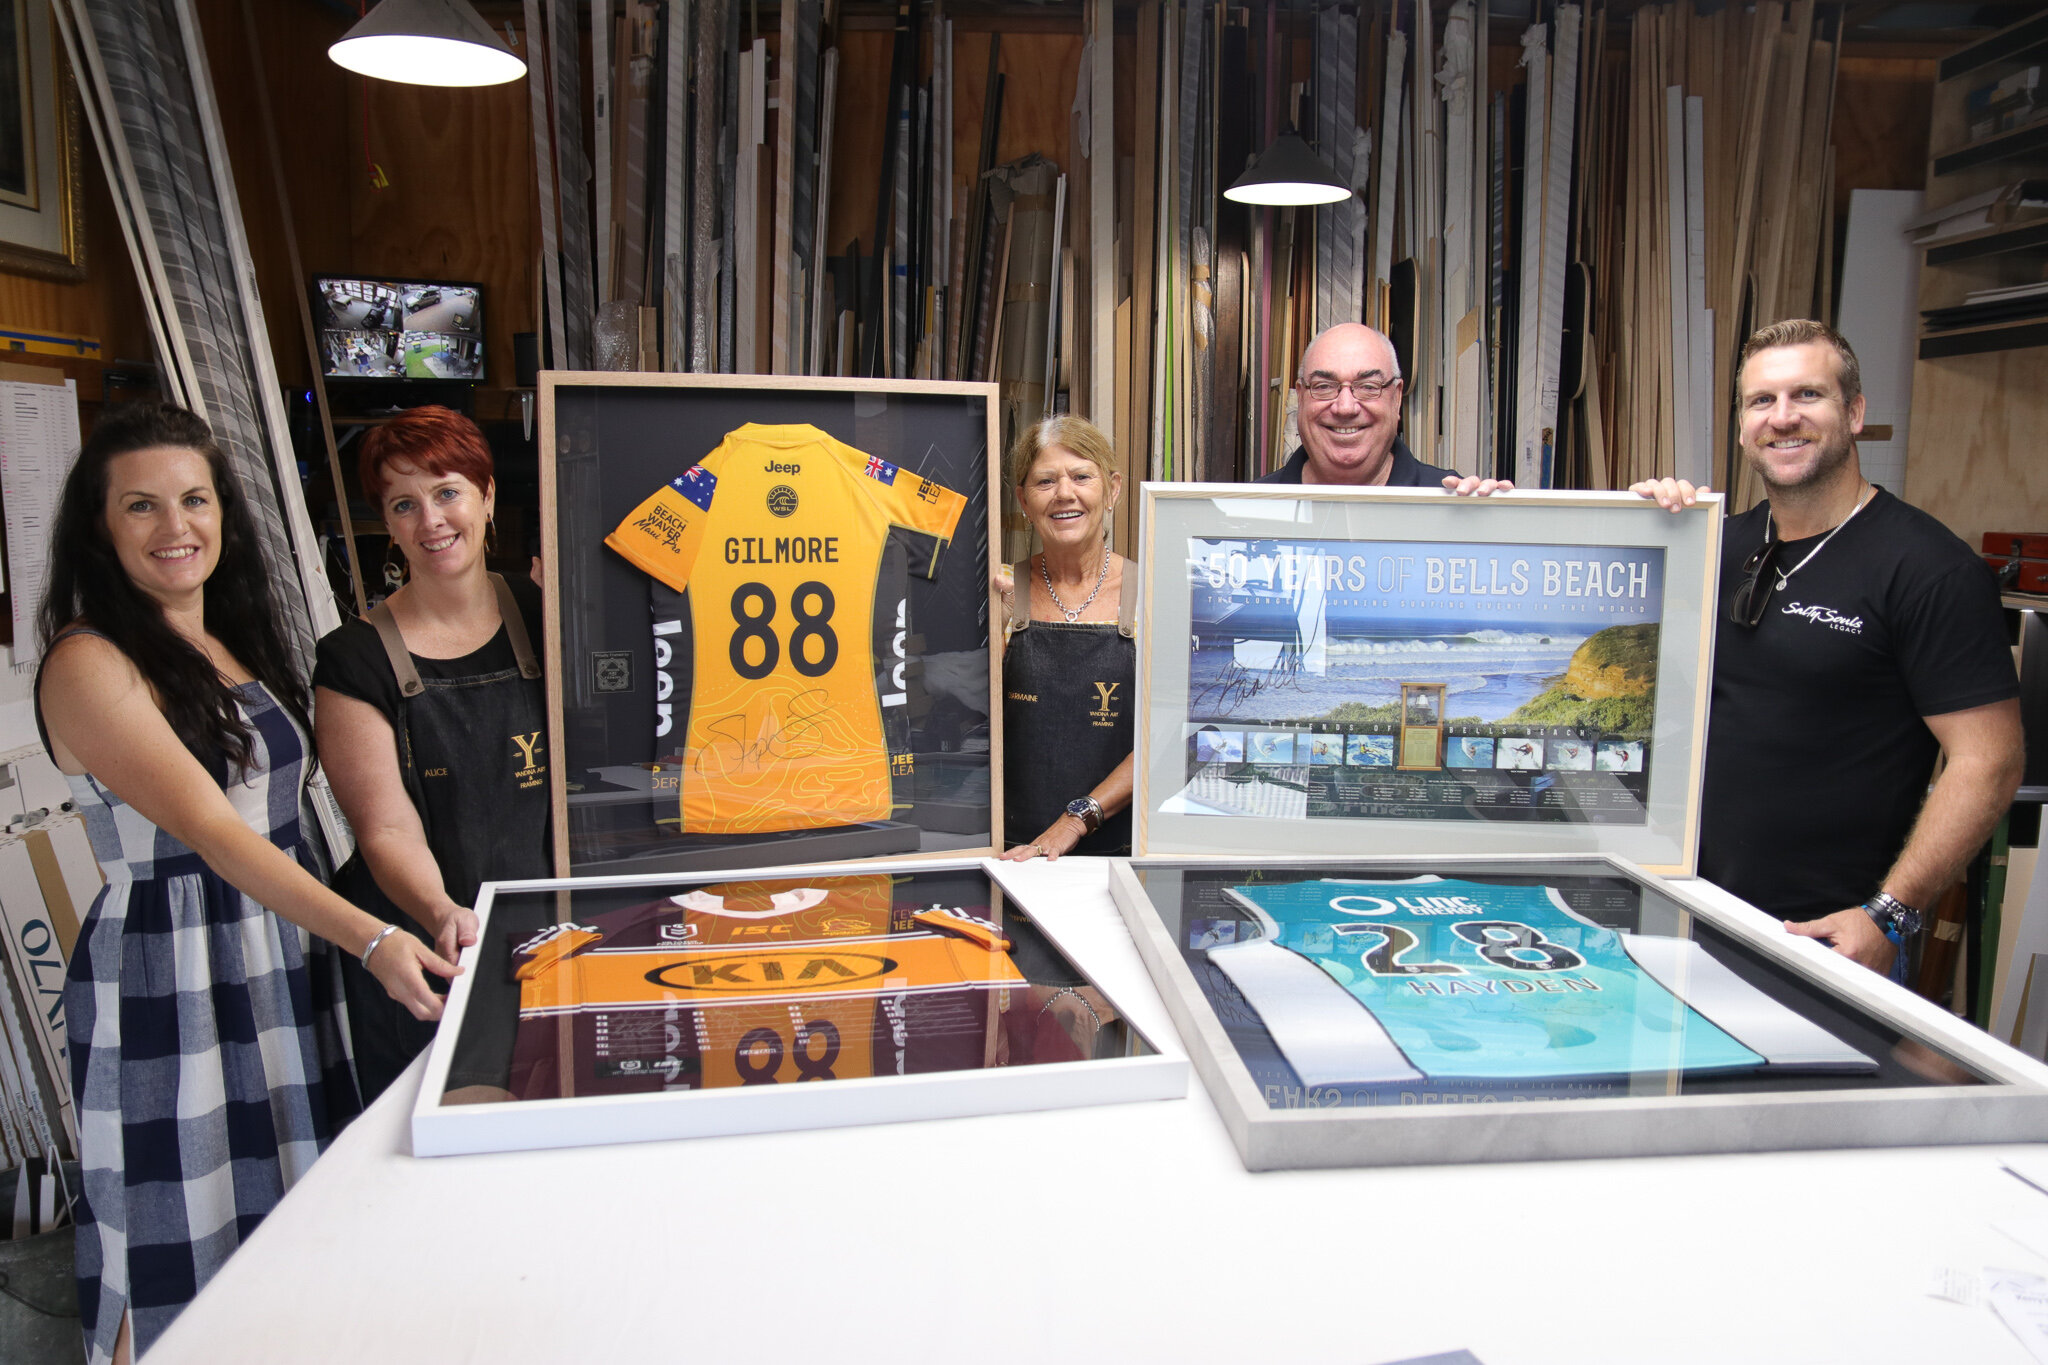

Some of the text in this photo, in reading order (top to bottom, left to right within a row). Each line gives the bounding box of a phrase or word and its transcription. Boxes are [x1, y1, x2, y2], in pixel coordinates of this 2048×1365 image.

[764, 460, 801, 476] Jeep
[648, 512, 682, 542] WAVER
[653, 505, 687, 532] BEACH
[633, 518, 681, 554] Maui Pro
[725, 537, 839, 564] GILMORE
[1208, 553, 1648, 599] 50 YEARS OF BELLS BEACH
[1401, 600, 1465, 609] SURFING
[1561, 604, 1586, 612] THE
[1598, 605, 1646, 613] WORLD
[1818, 610, 1863, 628] Souls
[729, 581, 839, 680] 88
[1829, 623, 1862, 635] LEGACY
[1093, 682, 1120, 711] Y
[1268, 722, 1585, 737] LEGENDS OF BELLS BEACH
[510, 731, 541, 769] Y
[891, 753, 914, 765] JEE
[425, 767, 448, 778] ALICE
[514, 769, 536, 778] YANDINA
[892, 765, 914, 776] LEA
[520, 779, 543, 789] FRAMING
[731, 923, 794, 936] ISC
[1329, 920, 1588, 977] 28
[690, 958, 859, 985] KIA
[1406, 976, 1603, 996] HAYDEN
